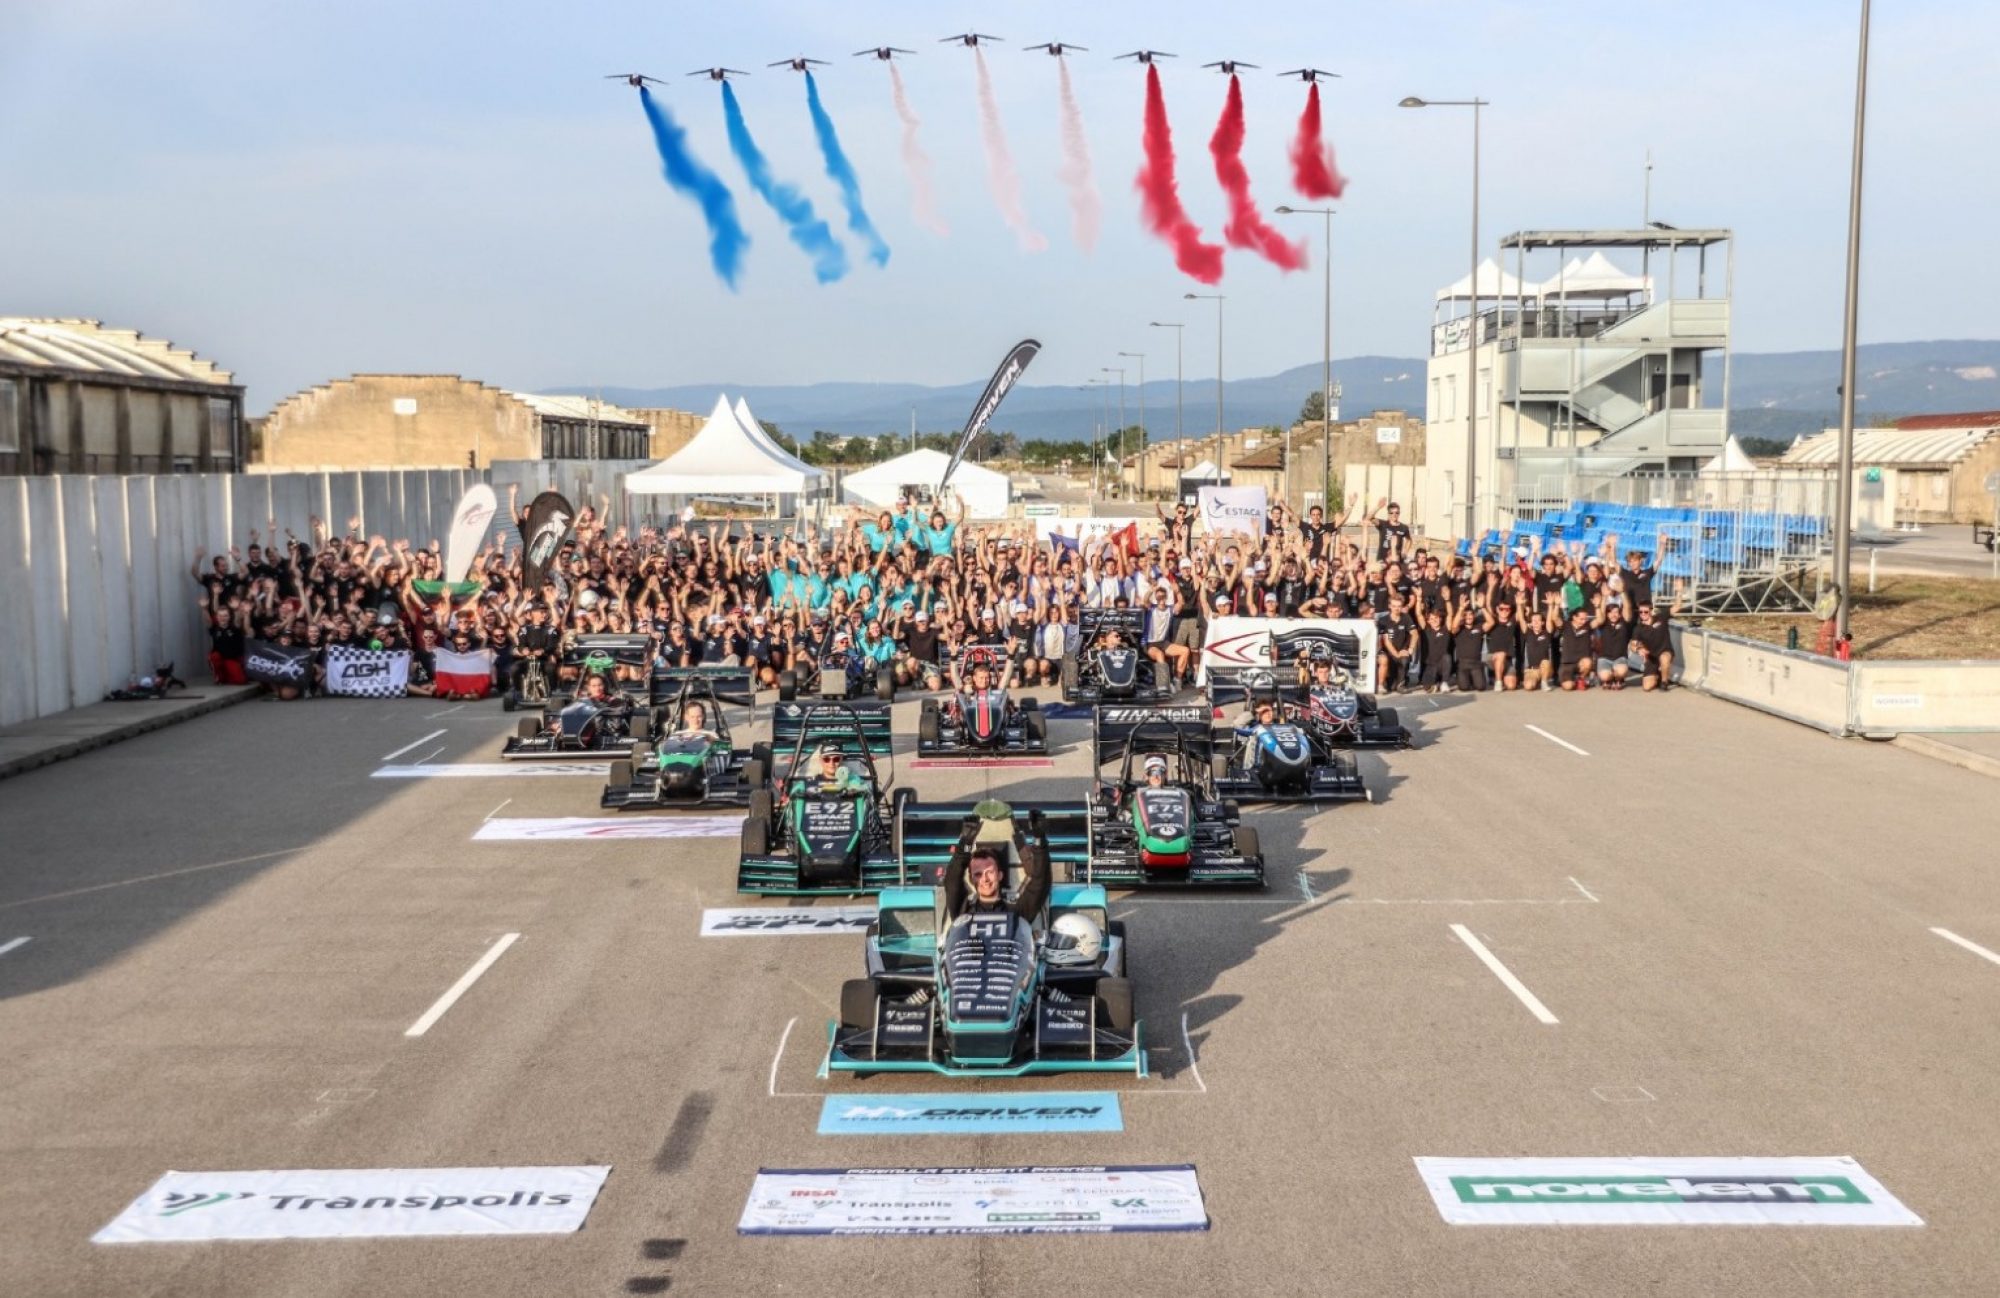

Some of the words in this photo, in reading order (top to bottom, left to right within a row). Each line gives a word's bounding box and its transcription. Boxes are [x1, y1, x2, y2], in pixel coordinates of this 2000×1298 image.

[341, 677, 391, 687] RACING
[805, 801, 855, 814] E92
[1147, 804, 1184, 814] E72
[970, 923, 1007, 937] H1
[1470, 1178, 1844, 1197] norelem
[270, 1190, 573, 1210] Transpolis
